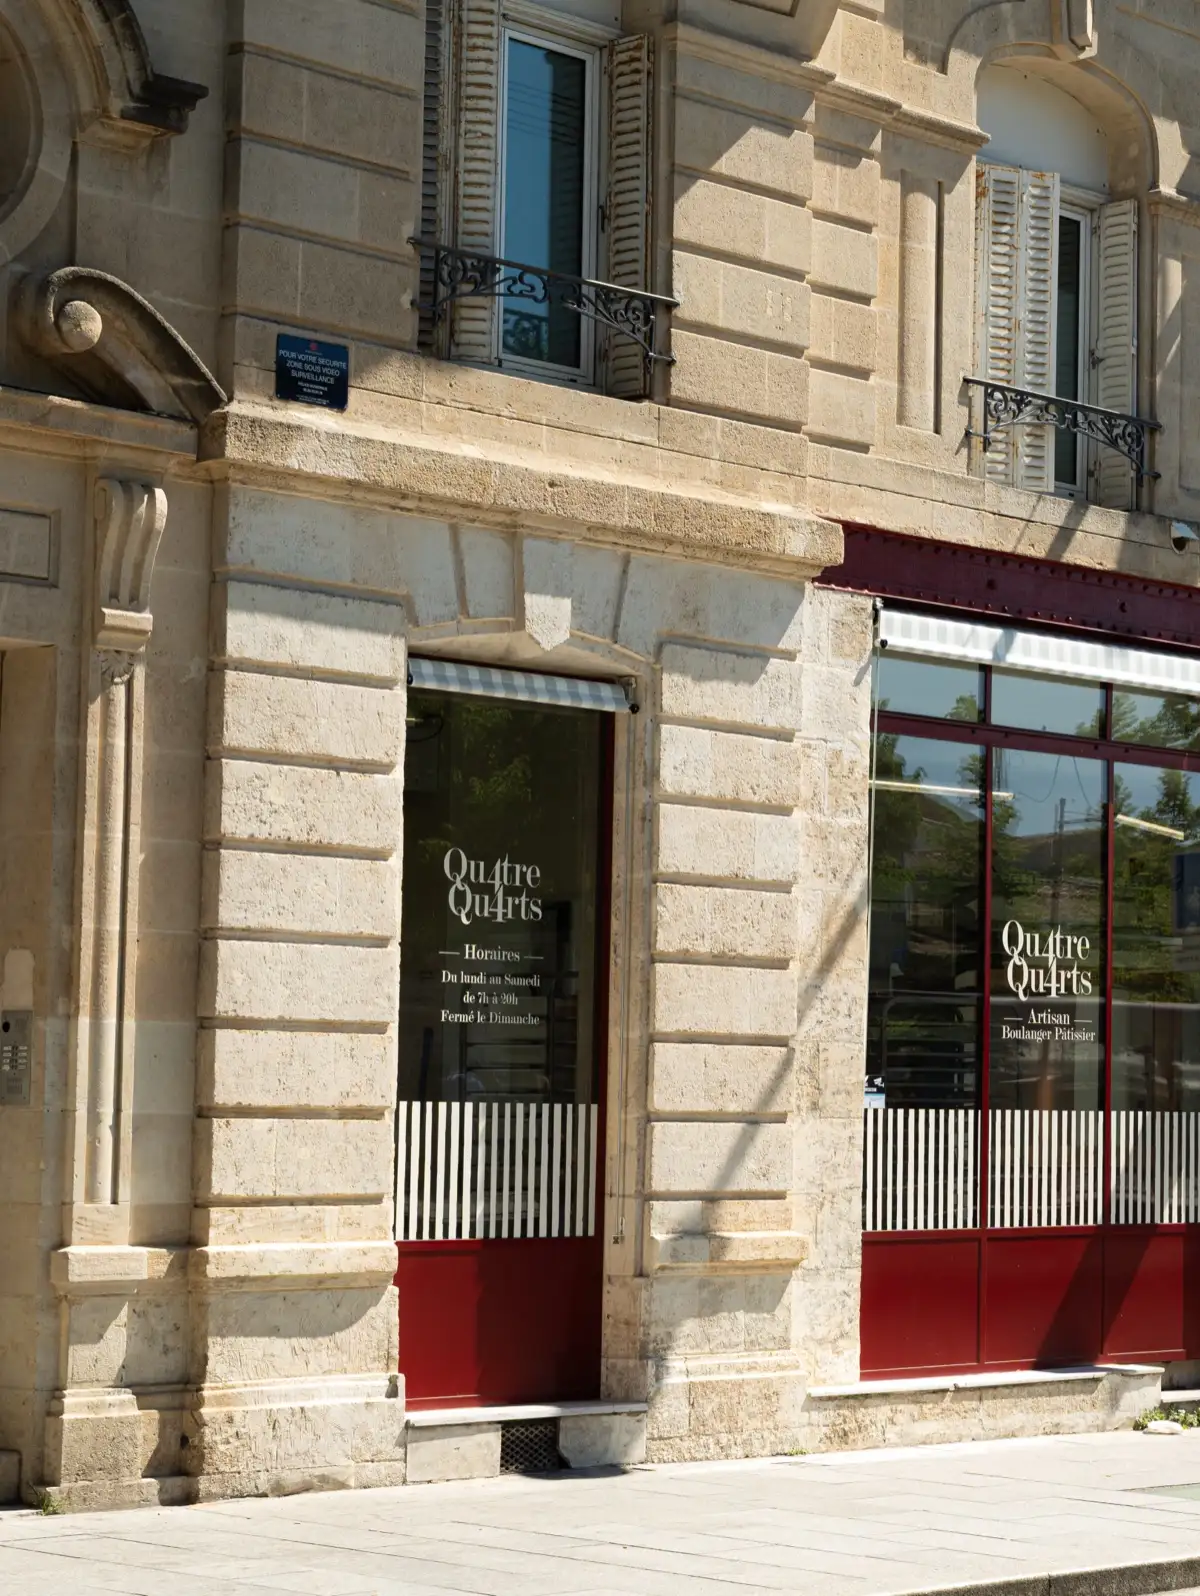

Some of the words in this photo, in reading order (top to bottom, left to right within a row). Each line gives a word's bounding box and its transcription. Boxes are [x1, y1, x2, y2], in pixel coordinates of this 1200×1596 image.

[279, 349, 297, 360] POUR
[297, 352, 317, 364] VOTRE
[286, 360, 303, 370] ZONE
[304, 363, 321, 373] SOUS
[291, 369, 335, 385] SURVEILLANCE
[464, 943, 520, 961] Horaires
[441, 970, 457, 984] Du
[460, 970, 487, 985] lundi
[489, 975, 501, 985] au
[504, 973, 540, 987] Samedi
[463, 990, 475, 1004] de
[477, 991, 489, 1004] 7h
[492, 992, 498, 1005] à
[500, 992, 518, 1005] 20h
[440, 1009, 474, 1023] Fermé
[477, 1010, 486, 1024] le
[489, 1011, 540, 1026] Dimanche
[1028, 1008, 1070, 1025] Artisan
[1002, 1025, 1052, 1043] Boulanger
[1055, 1026, 1096, 1041] Pâtissier
